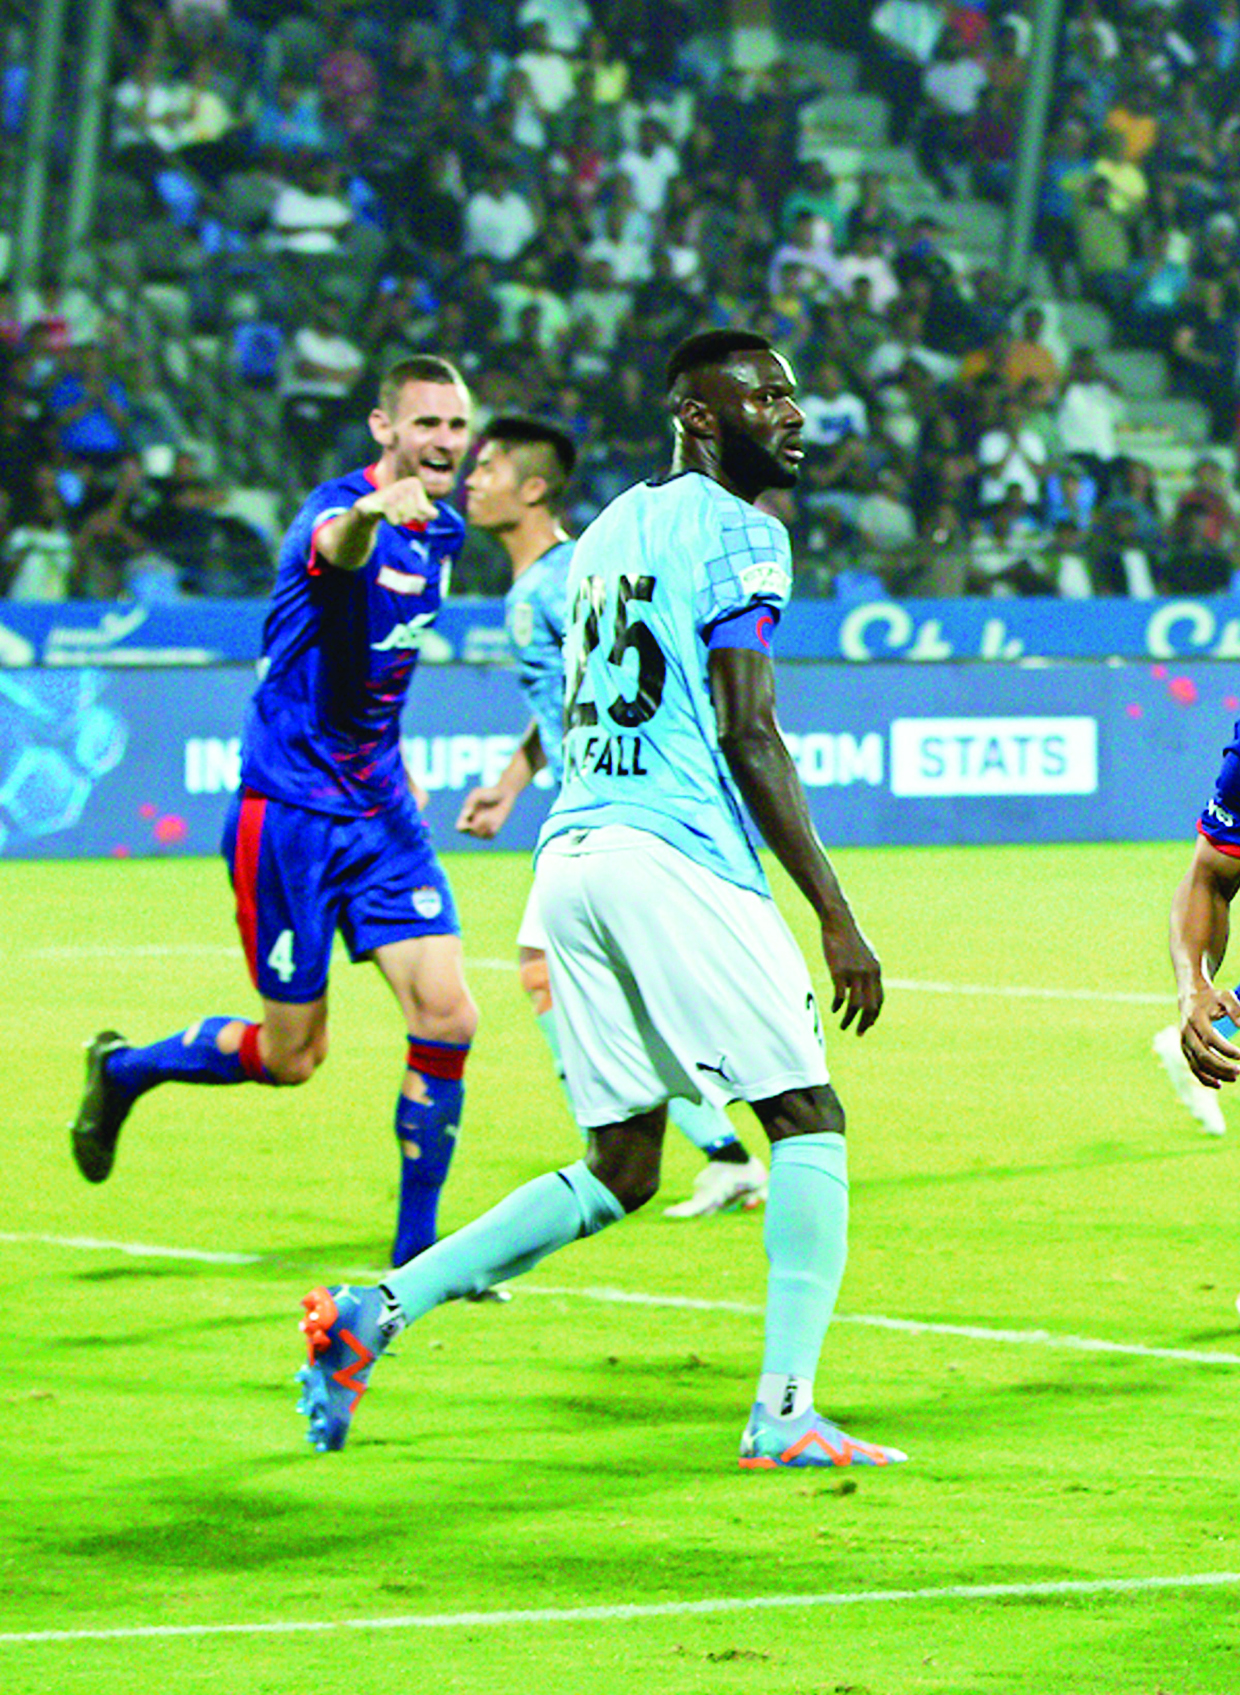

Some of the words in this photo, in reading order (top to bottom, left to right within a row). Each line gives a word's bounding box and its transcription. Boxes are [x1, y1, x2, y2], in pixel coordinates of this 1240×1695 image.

[564, 575, 668, 728] 25
[920, 735, 1066, 778] STATS
[267, 928, 297, 983] 4
